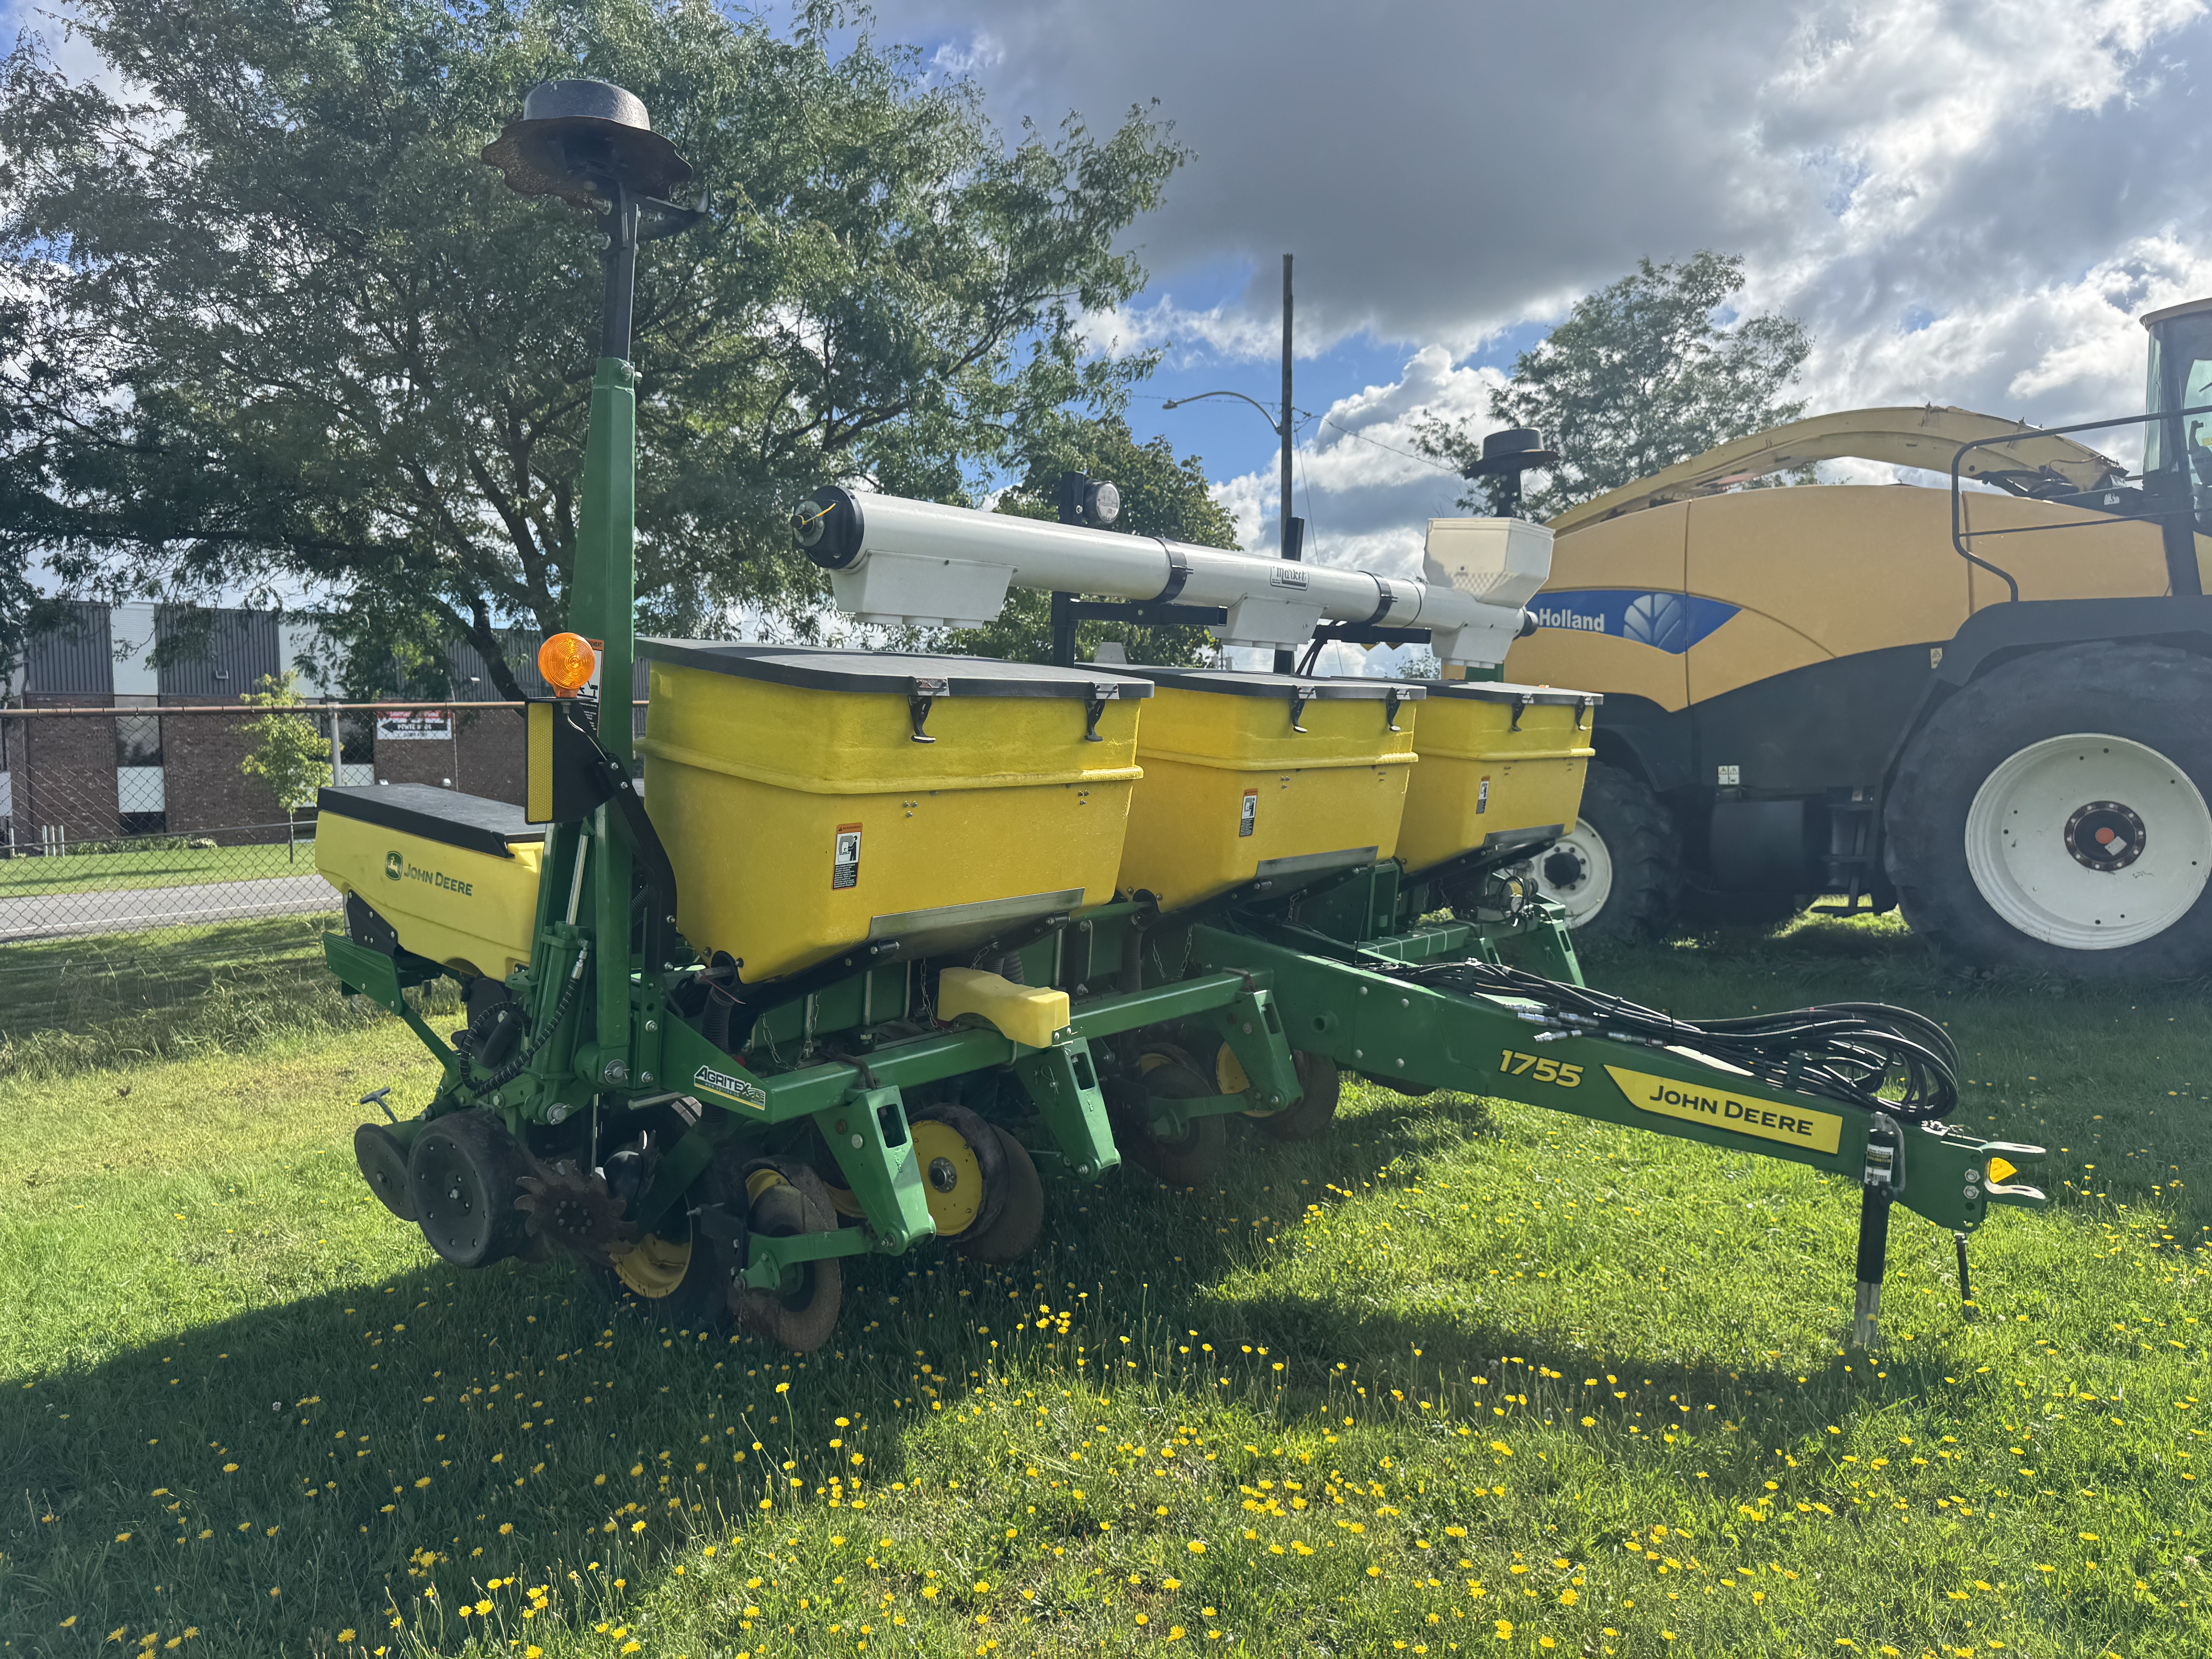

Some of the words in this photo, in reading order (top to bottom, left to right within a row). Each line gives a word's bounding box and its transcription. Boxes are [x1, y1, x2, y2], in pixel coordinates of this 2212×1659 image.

[1539, 608, 1604, 632] Holland
[404, 863, 433, 884] JOHN
[435, 872, 473, 896] DEERE
[695, 1066, 751, 1096] AGRITEX
[1499, 1049, 1585, 1088] 1755
[1649, 1085, 1718, 1115] JOHN
[1724, 1100, 1814, 1137] DEERE
